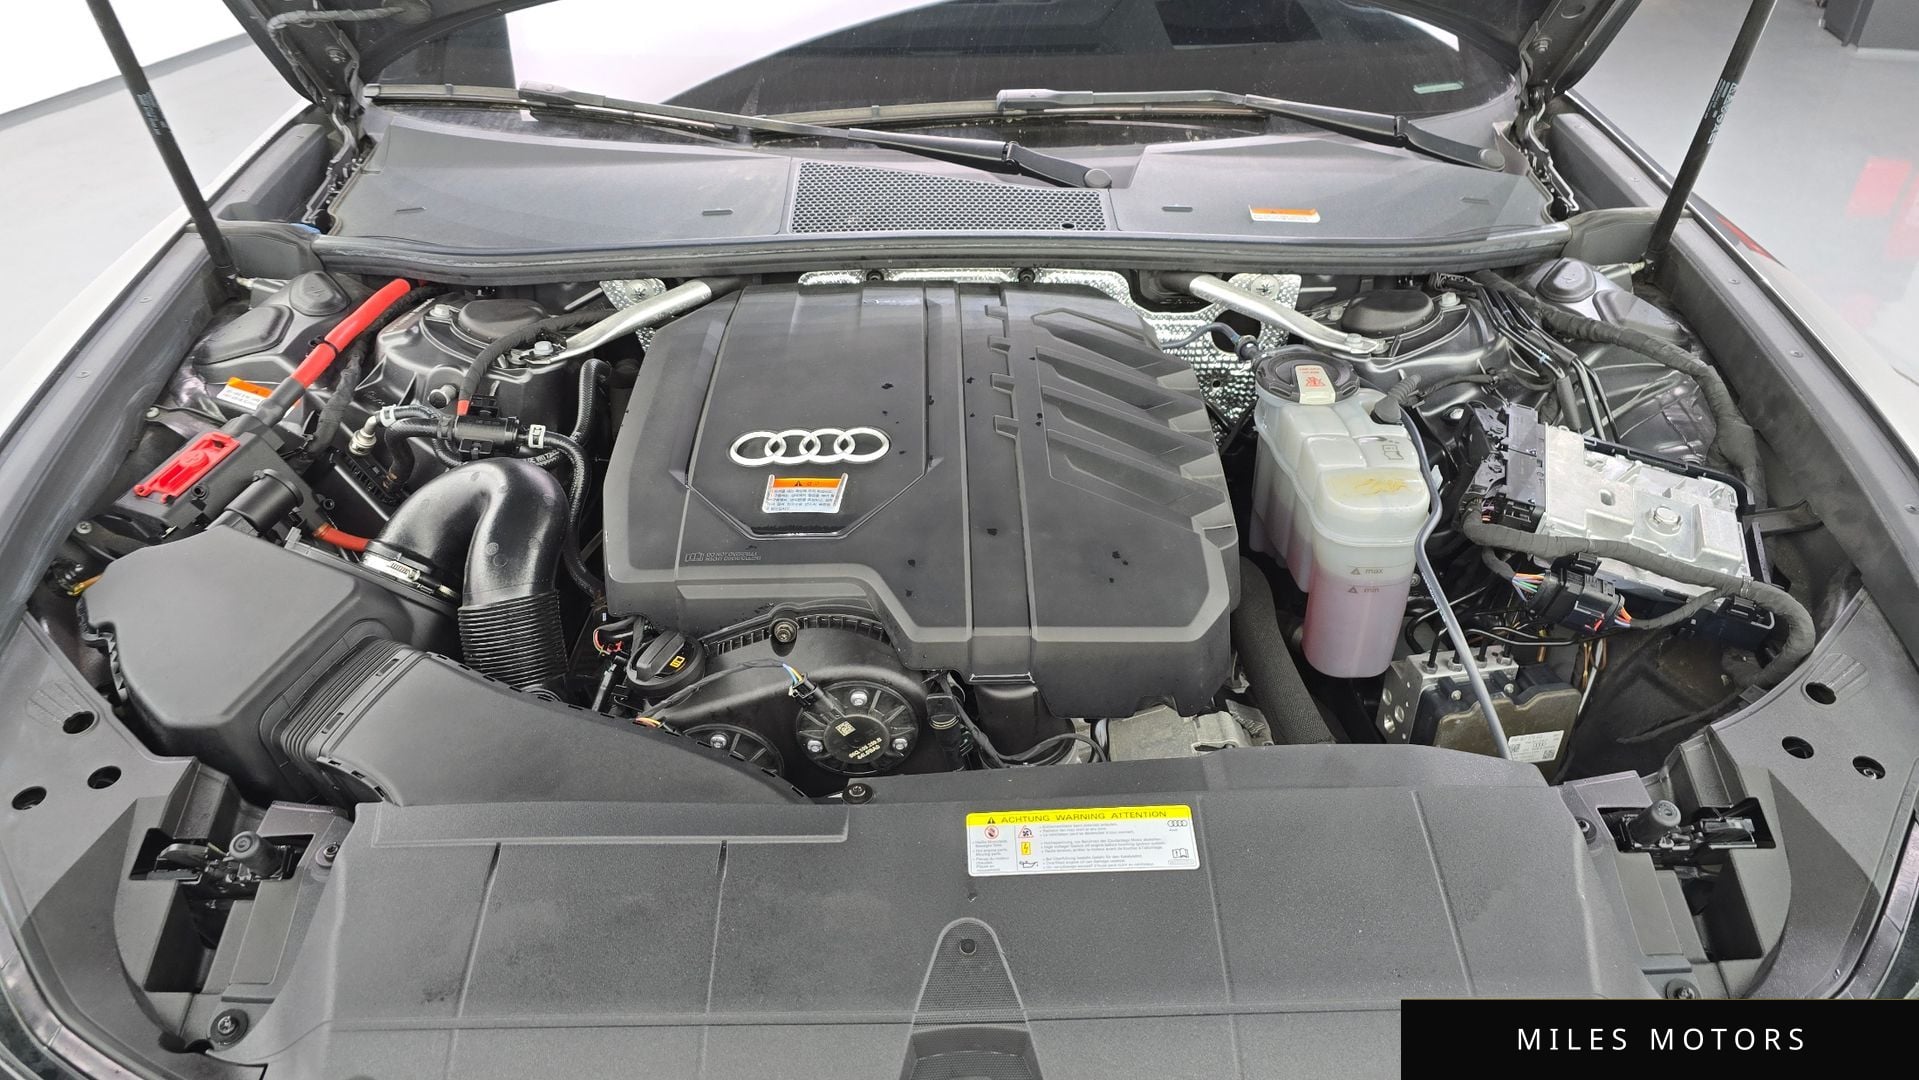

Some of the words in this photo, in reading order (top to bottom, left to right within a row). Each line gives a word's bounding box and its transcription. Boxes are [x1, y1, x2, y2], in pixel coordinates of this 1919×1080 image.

[1001, 814, 1050, 824] ACHTUNG
[1056, 812, 1106, 821] WARNING
[1111, 810, 1167, 820] ATTENTION
